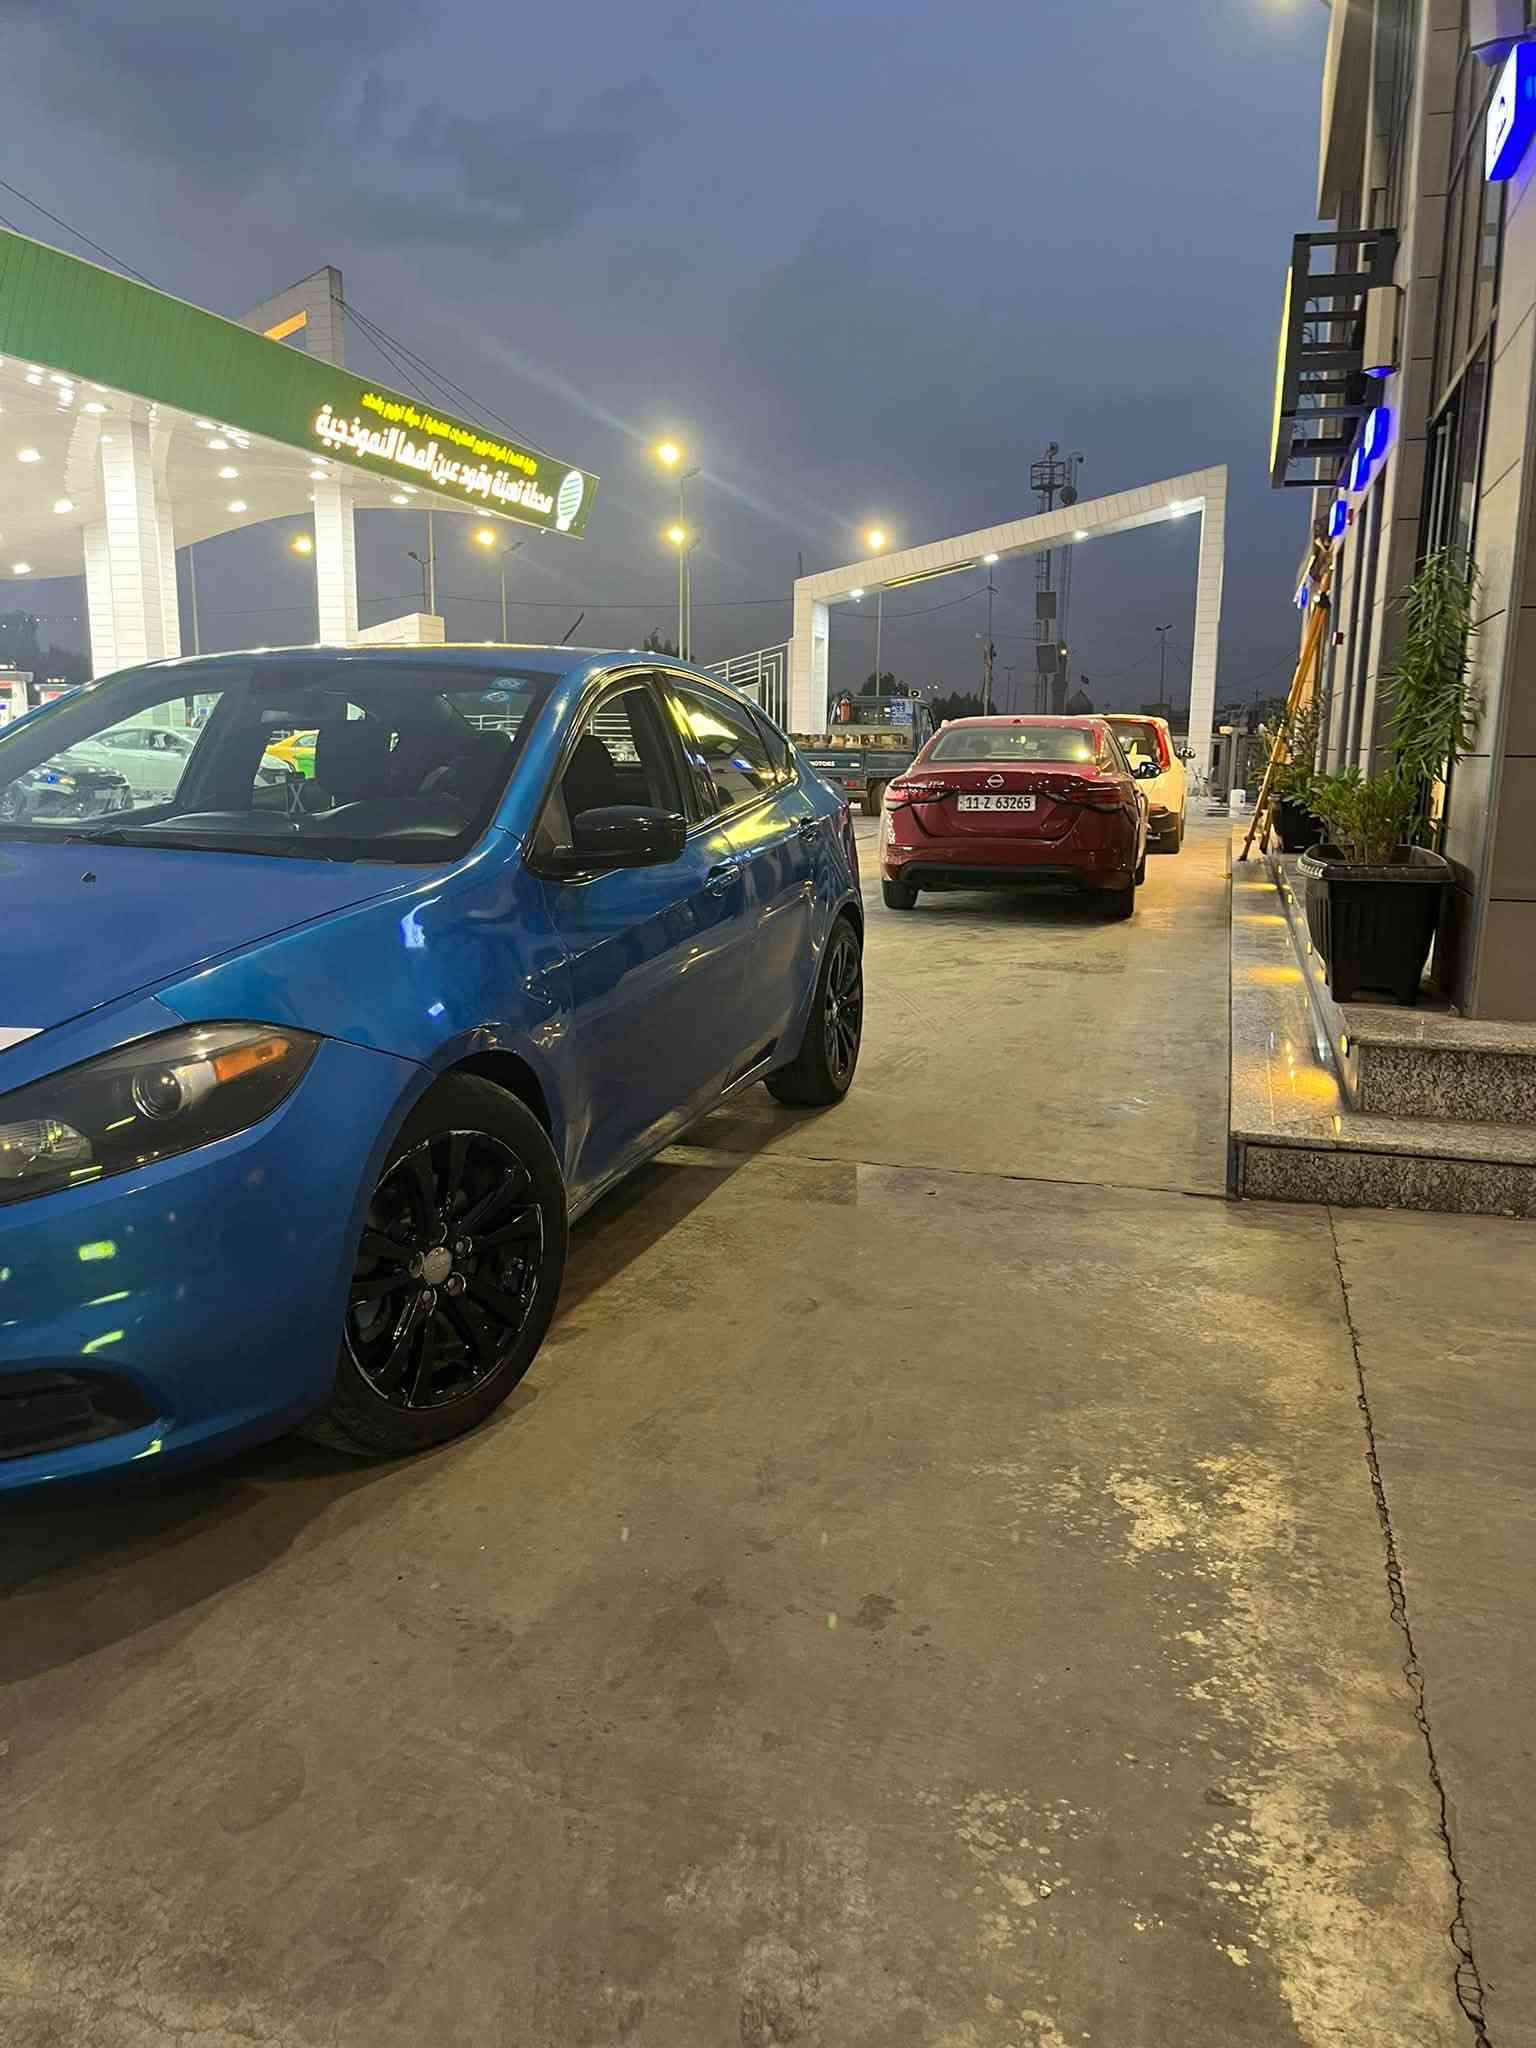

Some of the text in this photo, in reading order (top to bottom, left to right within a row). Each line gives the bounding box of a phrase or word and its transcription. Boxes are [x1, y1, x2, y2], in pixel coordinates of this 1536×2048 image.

[315, 404, 401, 461] النموذجية
[458, 463, 494, 499] وقود
[520, 481, 554, 514] محطة
[995, 796, 1031, 809] 63265
